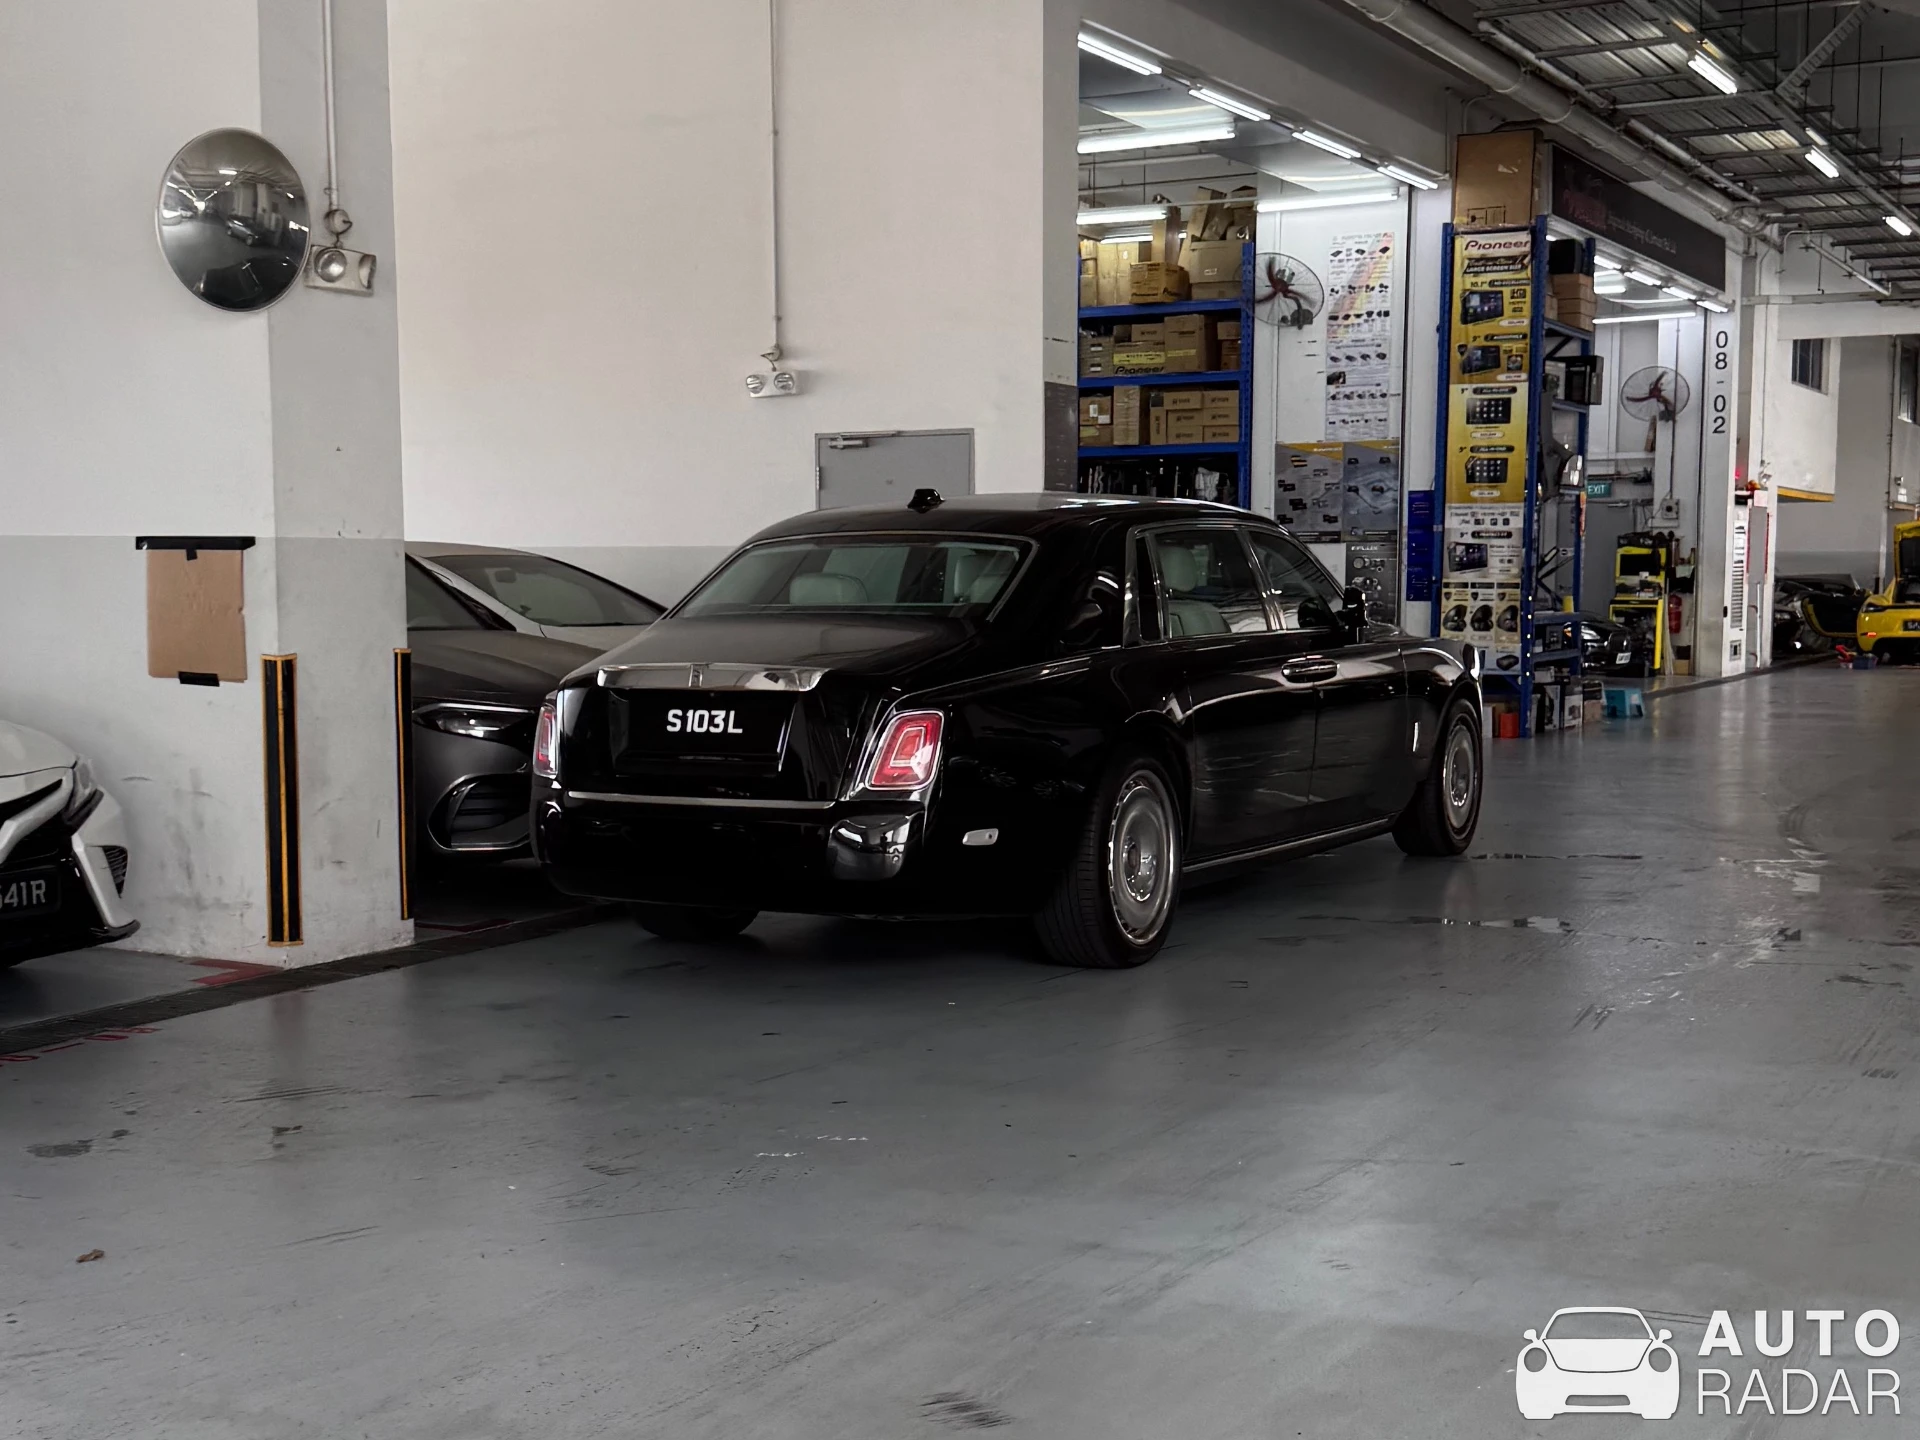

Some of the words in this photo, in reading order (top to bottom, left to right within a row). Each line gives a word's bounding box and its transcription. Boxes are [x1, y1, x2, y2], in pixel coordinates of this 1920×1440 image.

[1464, 240, 1530, 251] Pioneer
[1115, 366, 1164, 374] Pioneer
[1587, 484, 1605, 495] EXIT
[666, 708, 743, 733] S103L
[0, 879, 46, 908] 41R
